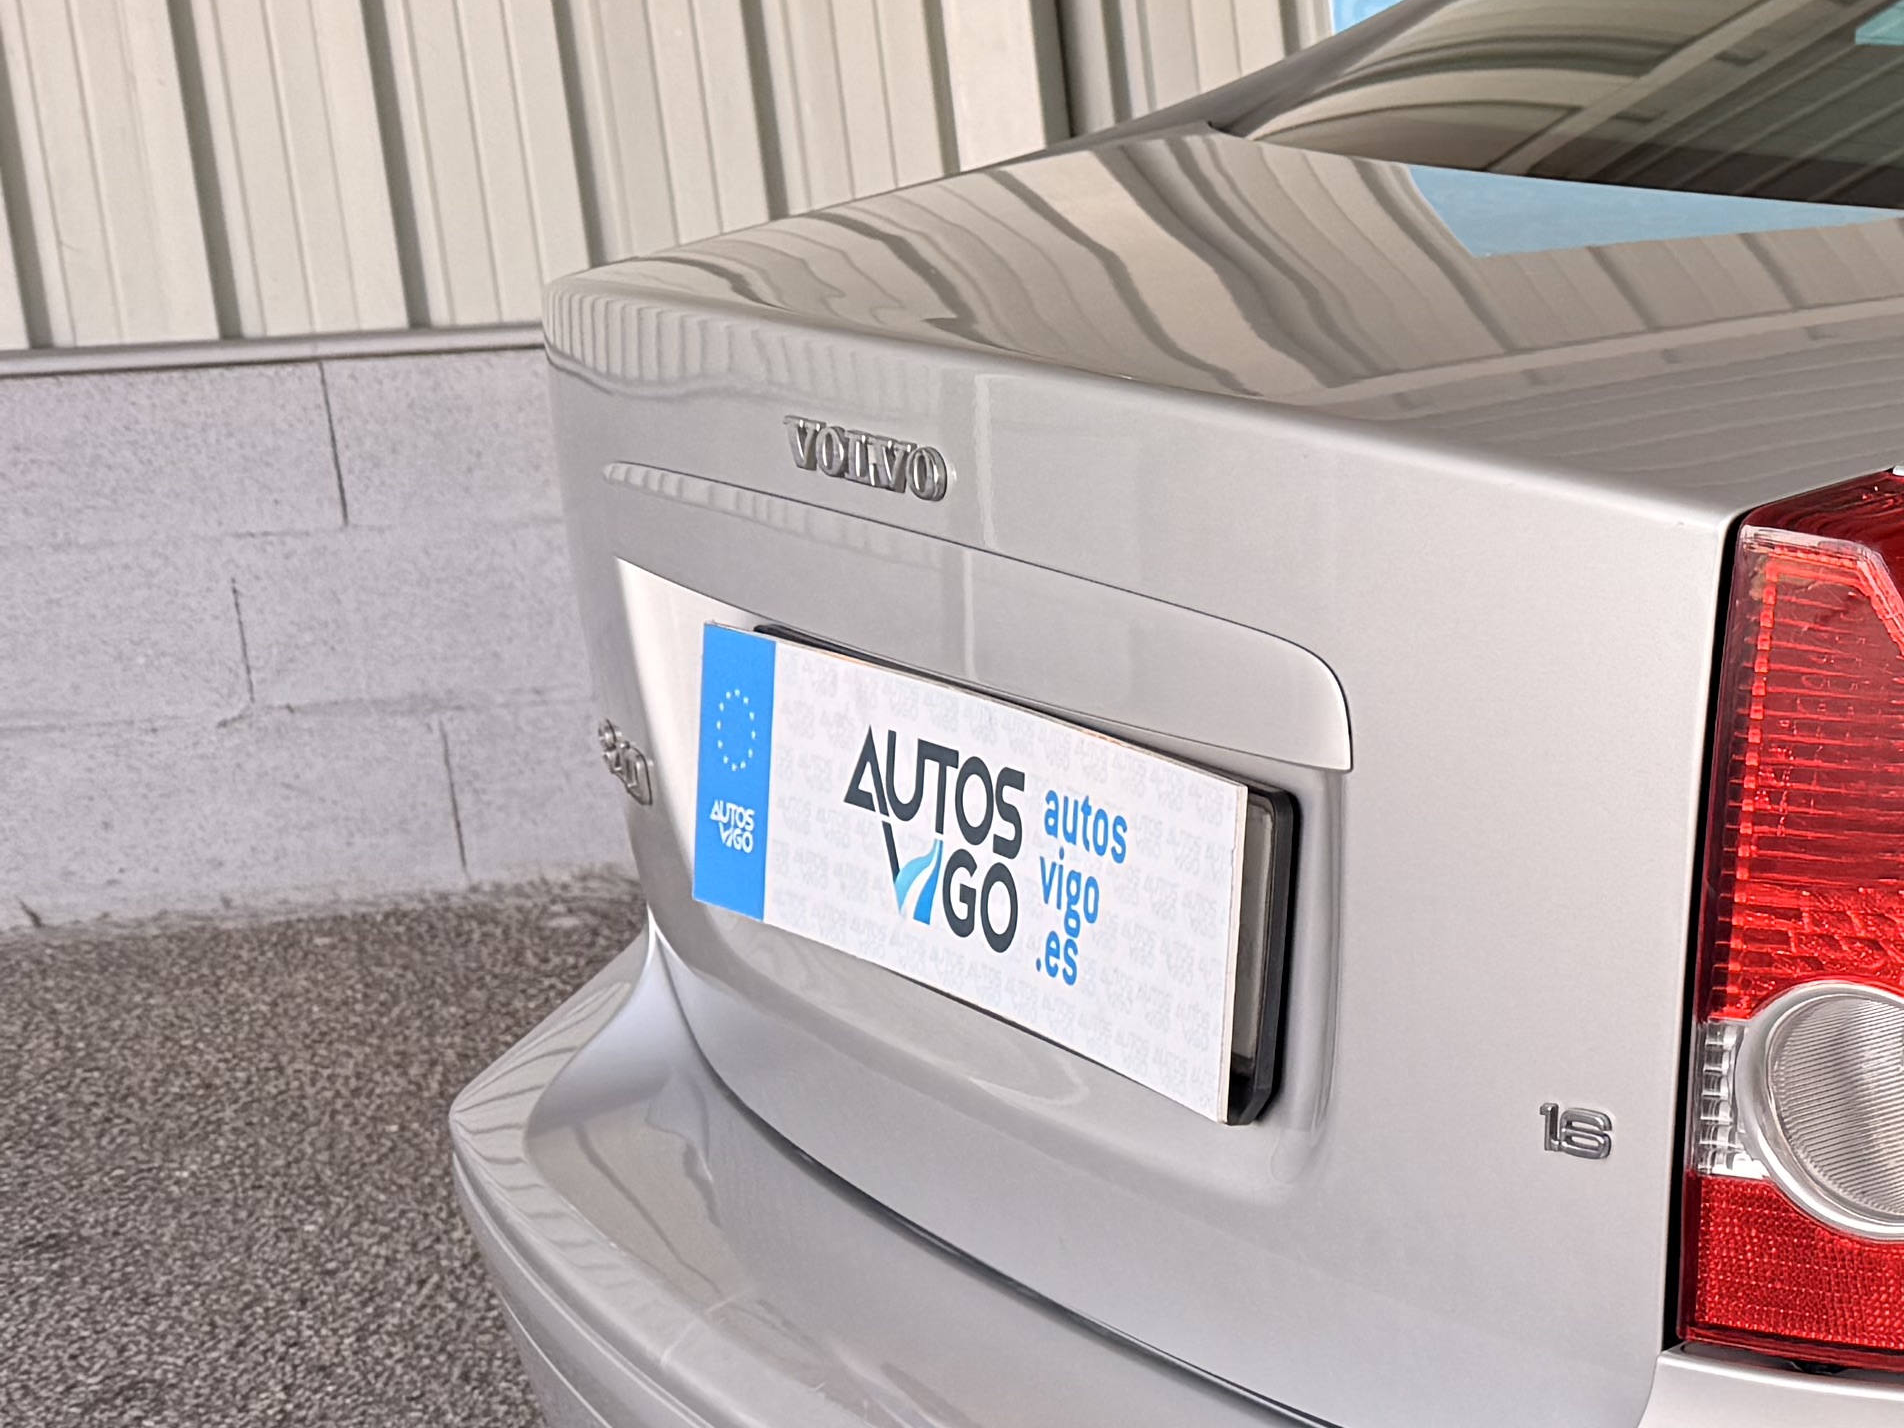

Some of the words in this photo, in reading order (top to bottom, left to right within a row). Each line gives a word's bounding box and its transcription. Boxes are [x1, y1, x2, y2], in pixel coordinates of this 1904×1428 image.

[783, 415, 948, 502] VOLVO
[709, 799, 755, 832] AUTOS
[844, 724, 1025, 860] AUTOS
[1044, 790, 1128, 864] autos
[1039, 847, 1100, 939] vigo
[1036, 931, 1079, 986] .es
